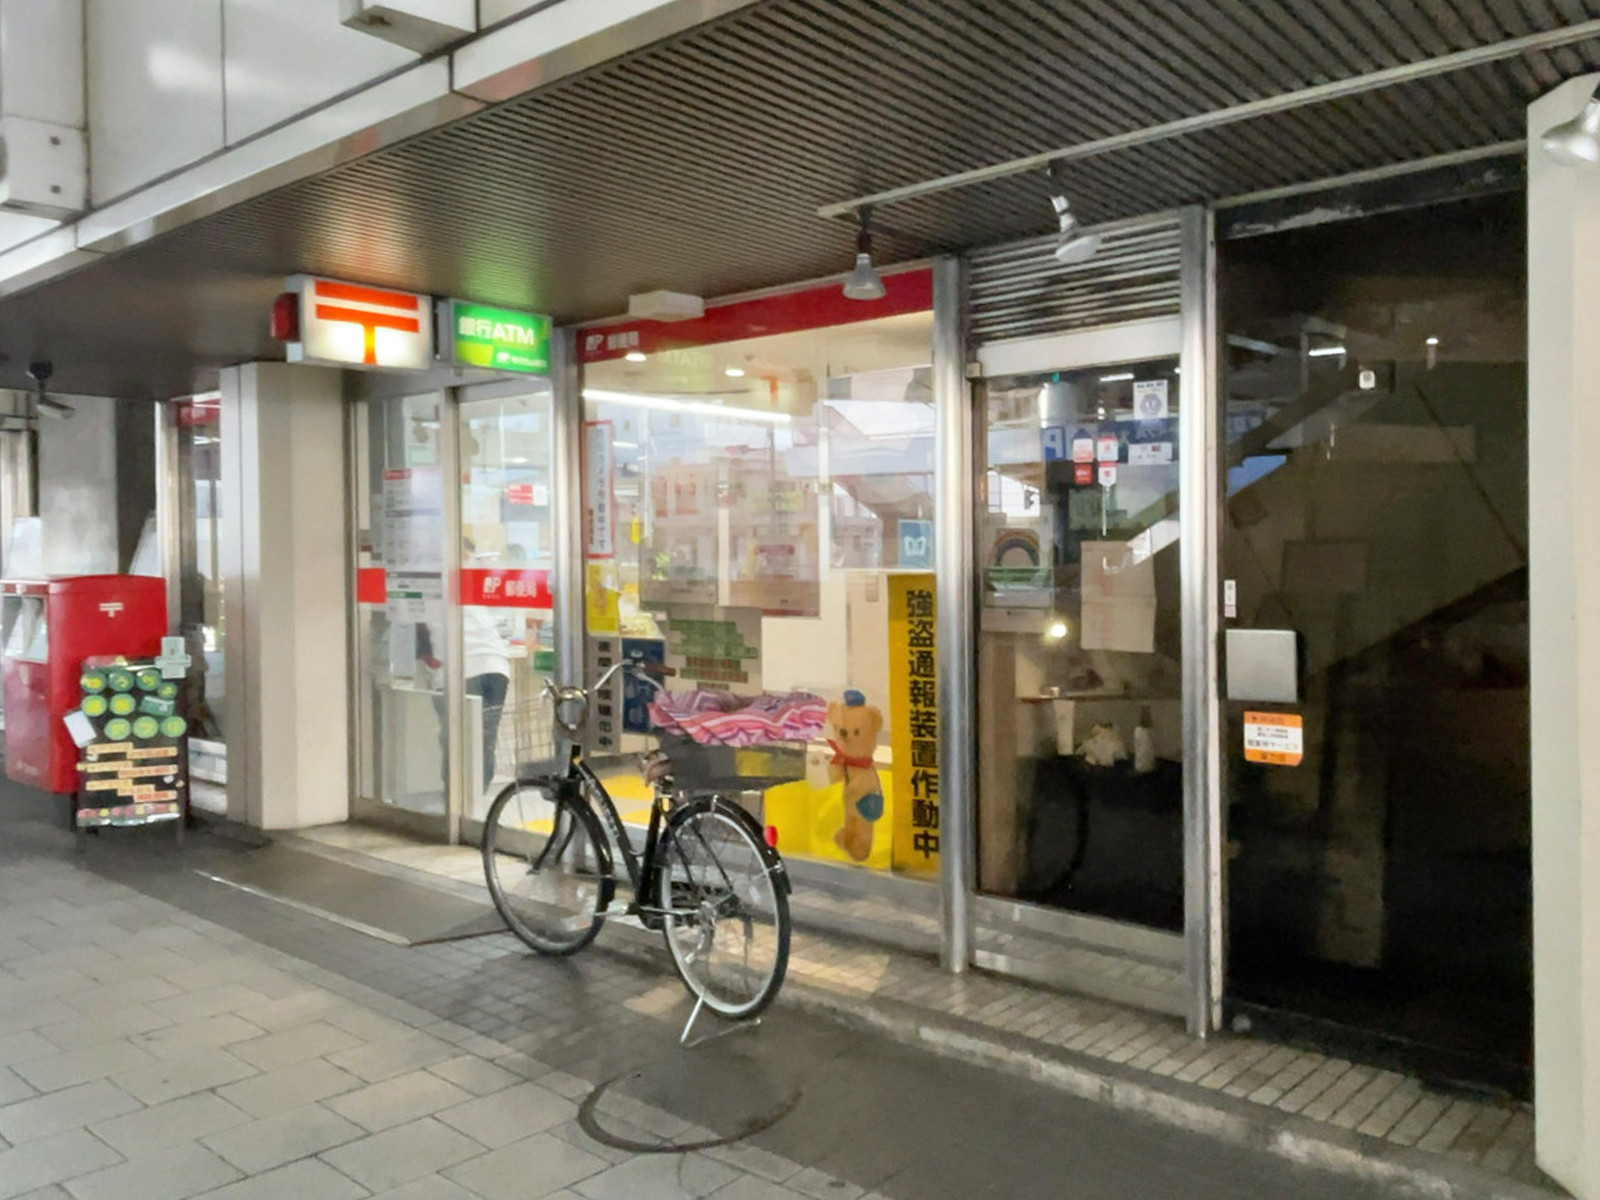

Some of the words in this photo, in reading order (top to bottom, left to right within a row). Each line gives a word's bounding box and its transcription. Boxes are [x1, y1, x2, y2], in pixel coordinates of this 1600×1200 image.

[906, 589, 940, 858] 強盗通報装置作動中
